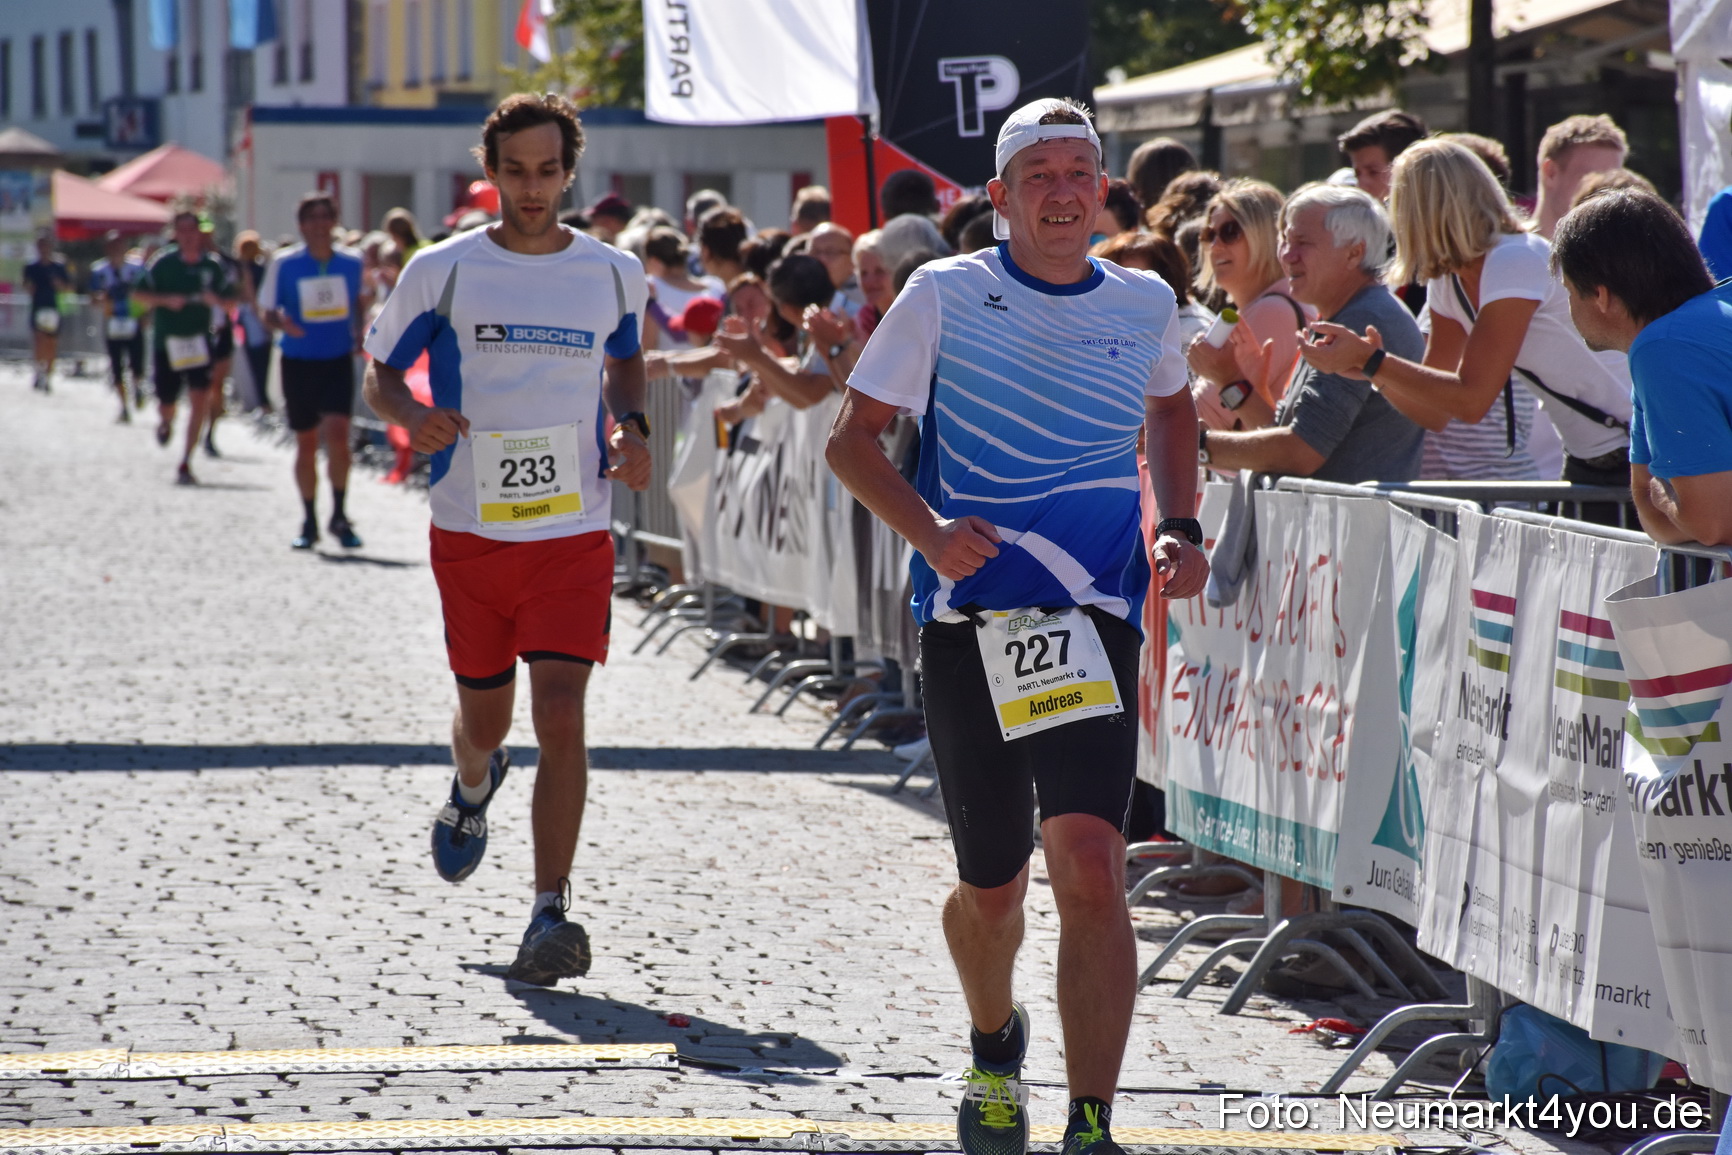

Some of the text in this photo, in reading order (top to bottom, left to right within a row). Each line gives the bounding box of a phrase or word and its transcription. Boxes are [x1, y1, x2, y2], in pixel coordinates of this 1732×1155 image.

[983, 301, 1008, 311] erima
[512, 327, 591, 346] BÜSCHEL
[1081, 338, 1137, 348] SKI-CLUB LAUF
[475, 343, 592, 360] FEINSCHNEIDTEAM
[502, 436, 551, 451] BOCK
[499, 455, 557, 489] 233
[499, 488, 553, 500] PARTL Neumarkt
[511, 503, 551, 519] Simon
[1004, 629, 1072, 679] 227
[995, 676, 1001, 685] C
[1017, 671, 1075, 693] PARTL Neumarkt
[1029, 690, 1084, 718] Andreas
[1271, 678, 1354, 782] BESSE
[1673, 837, 1732, 865] genieße
[1366, 860, 1392, 890] Jura
